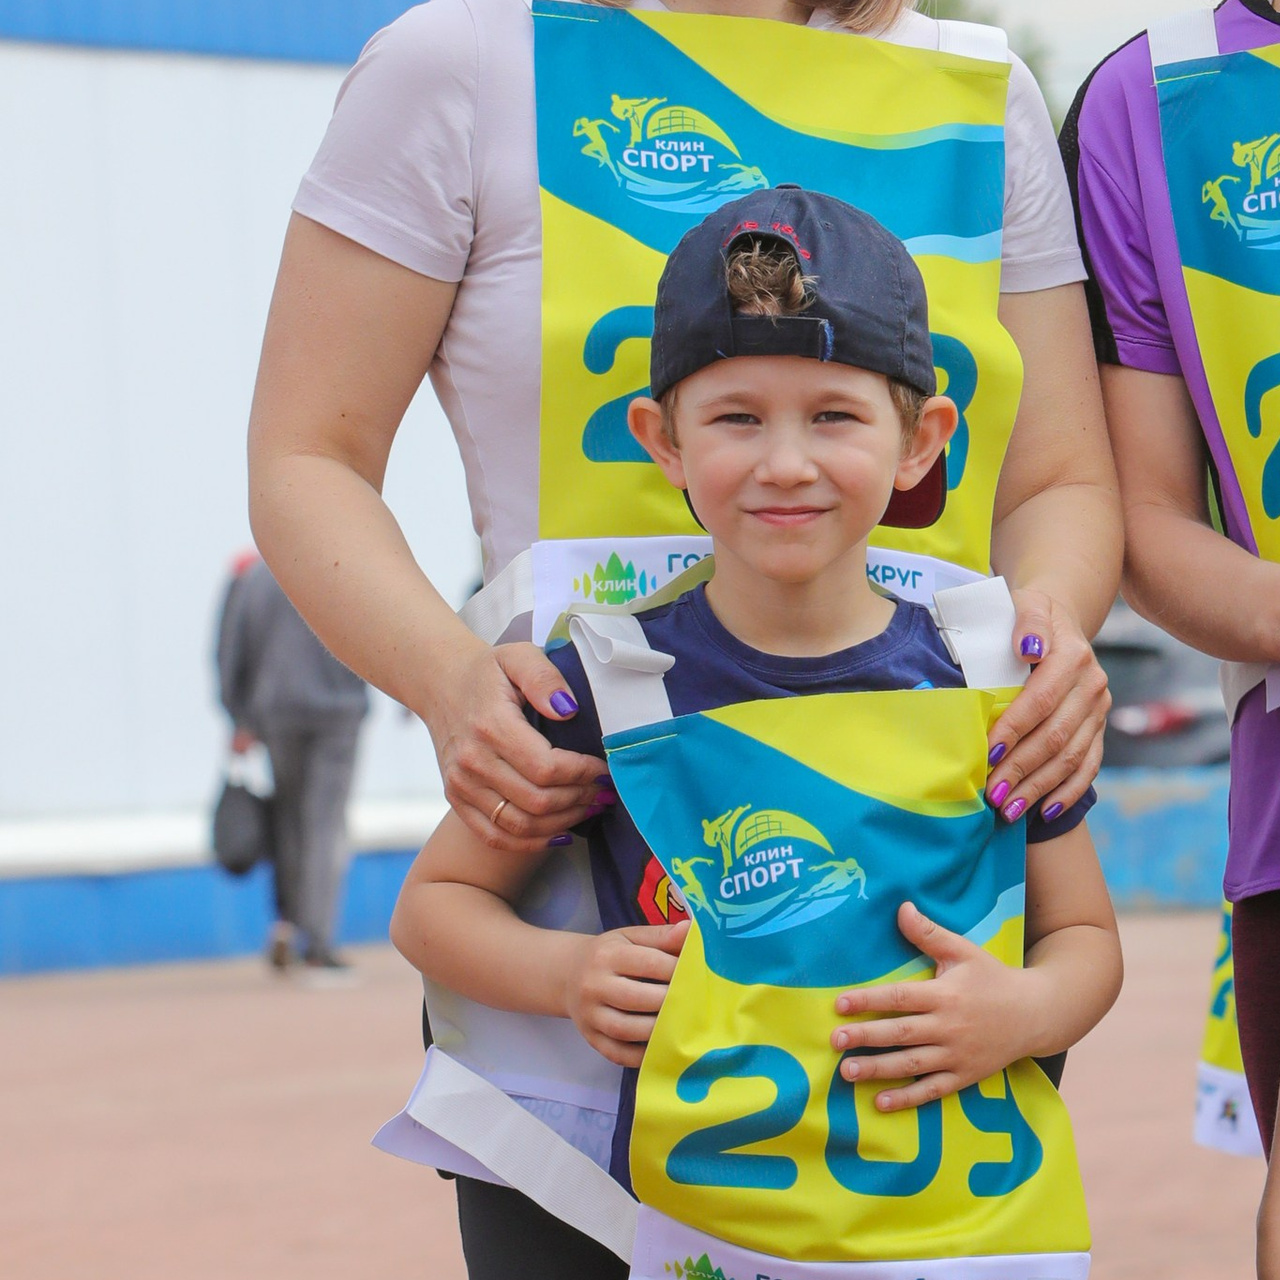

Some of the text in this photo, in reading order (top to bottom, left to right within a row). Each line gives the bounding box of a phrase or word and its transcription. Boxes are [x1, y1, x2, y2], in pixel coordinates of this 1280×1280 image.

[655, 139, 705, 152] КЛИН
[622, 148, 714, 173] СПОРТ
[593, 578, 637, 592] КЛИН
[866, 563, 923, 589] КРУГ
[744, 845, 793, 867] КЛИН
[720, 858, 804, 899] СПОРТ
